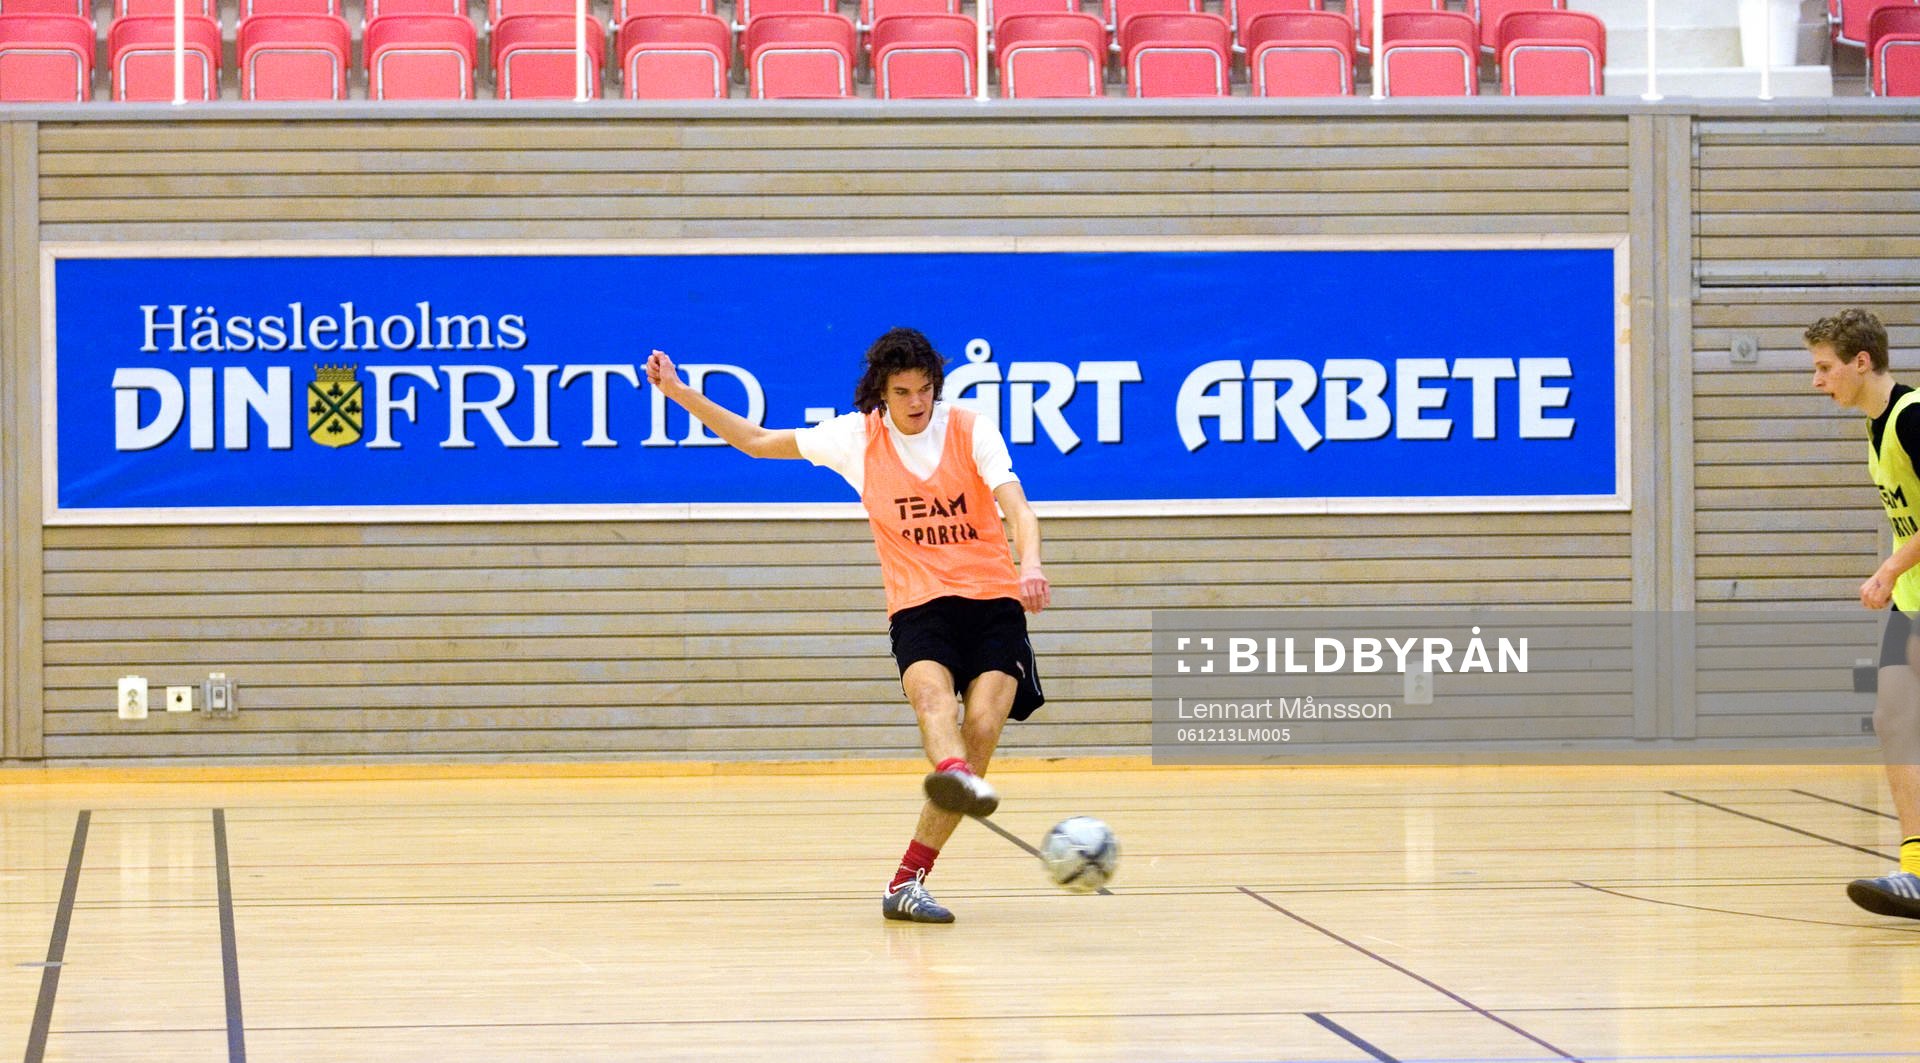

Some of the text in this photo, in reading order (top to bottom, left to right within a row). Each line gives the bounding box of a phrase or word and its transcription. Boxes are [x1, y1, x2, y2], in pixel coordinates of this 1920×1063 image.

[139, 301, 528, 353] Hässleholms
[111, 366, 292, 451] DIN
[365, 363, 766, 449] FRITID
[940, 337, 1143, 455] ÅRT
[1175, 356, 1577, 453] ARBETE
[894, 492, 968, 521] TEAM
